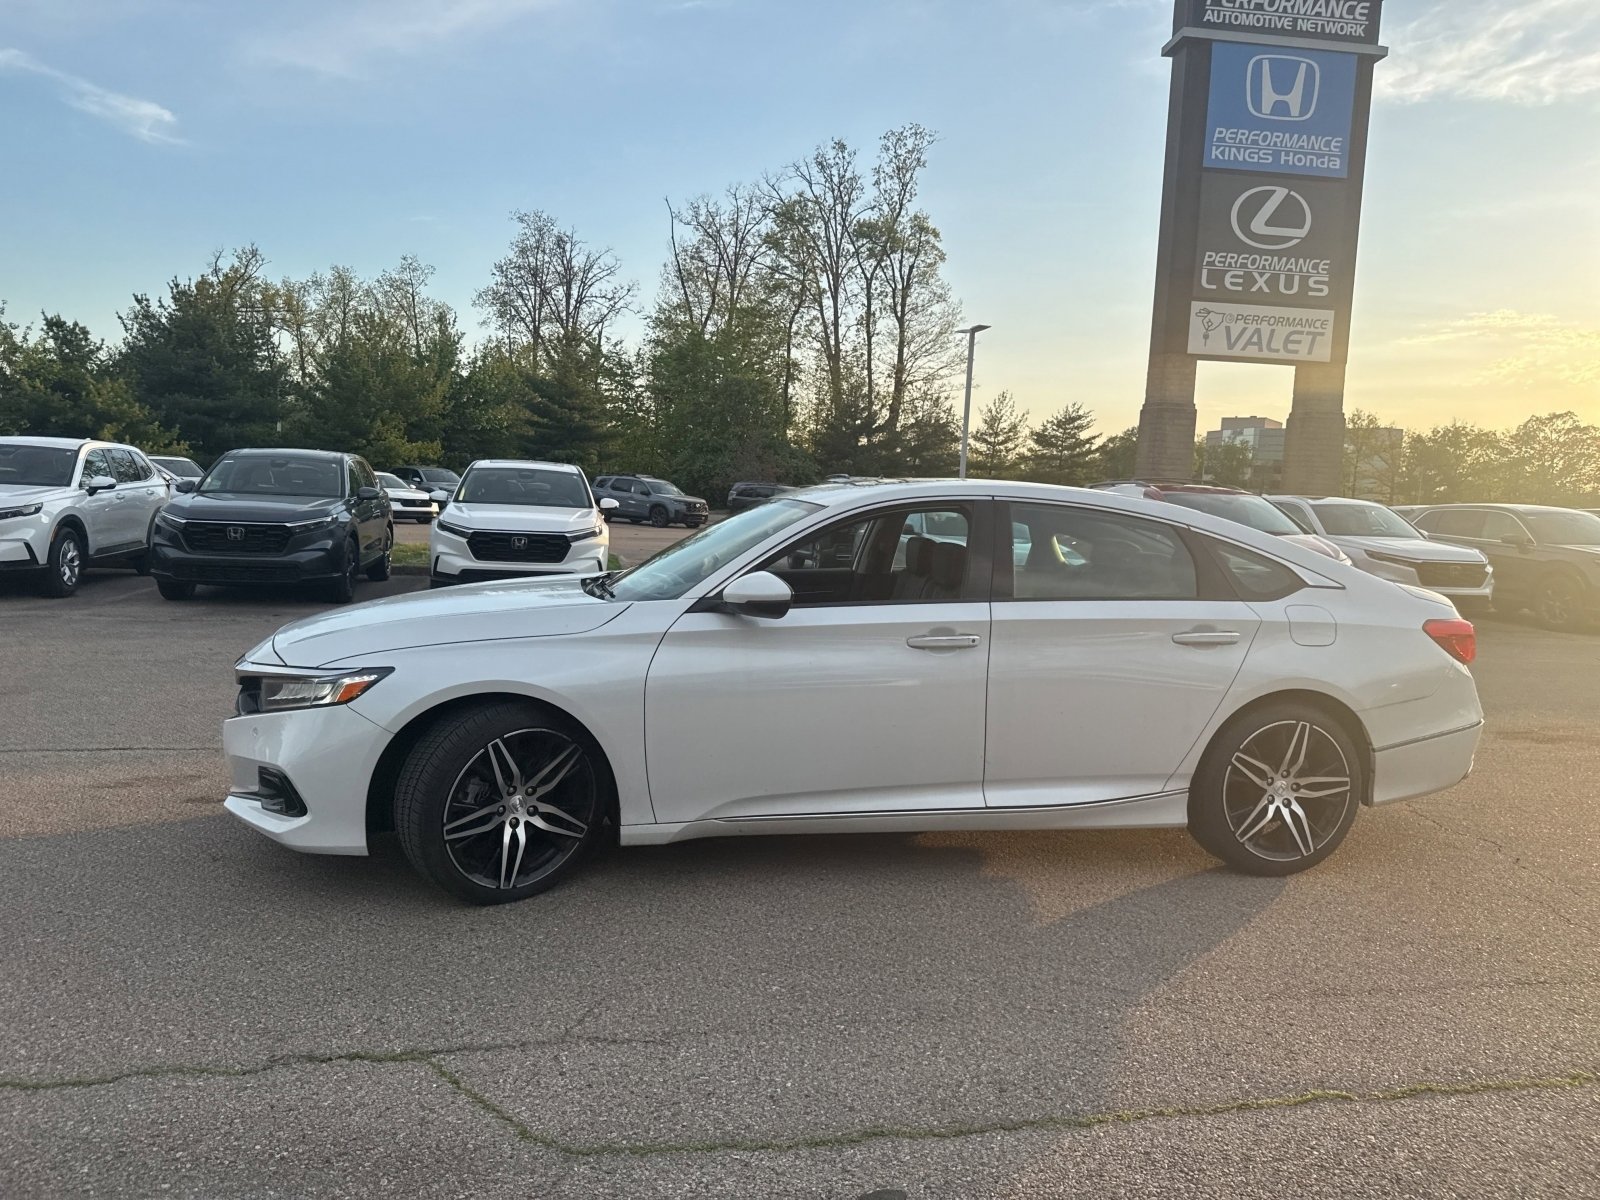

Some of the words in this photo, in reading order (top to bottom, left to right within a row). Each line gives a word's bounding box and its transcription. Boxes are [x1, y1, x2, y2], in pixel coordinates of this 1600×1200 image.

[1203, 9, 1293, 30] AUTOMOTIVE
[1296, 19, 1365, 37] NETWORK
[1213, 127, 1343, 152] PERFORMANCE
[1211, 146, 1273, 164] KINGS
[1280, 151, 1341, 169] Honda
[1202, 251, 1330, 274] PERFORMANCE
[1201, 268, 1330, 297] LEXUS
[1234, 313, 1329, 329] PERFORMANCE
[1224, 325, 1325, 355] VALET
